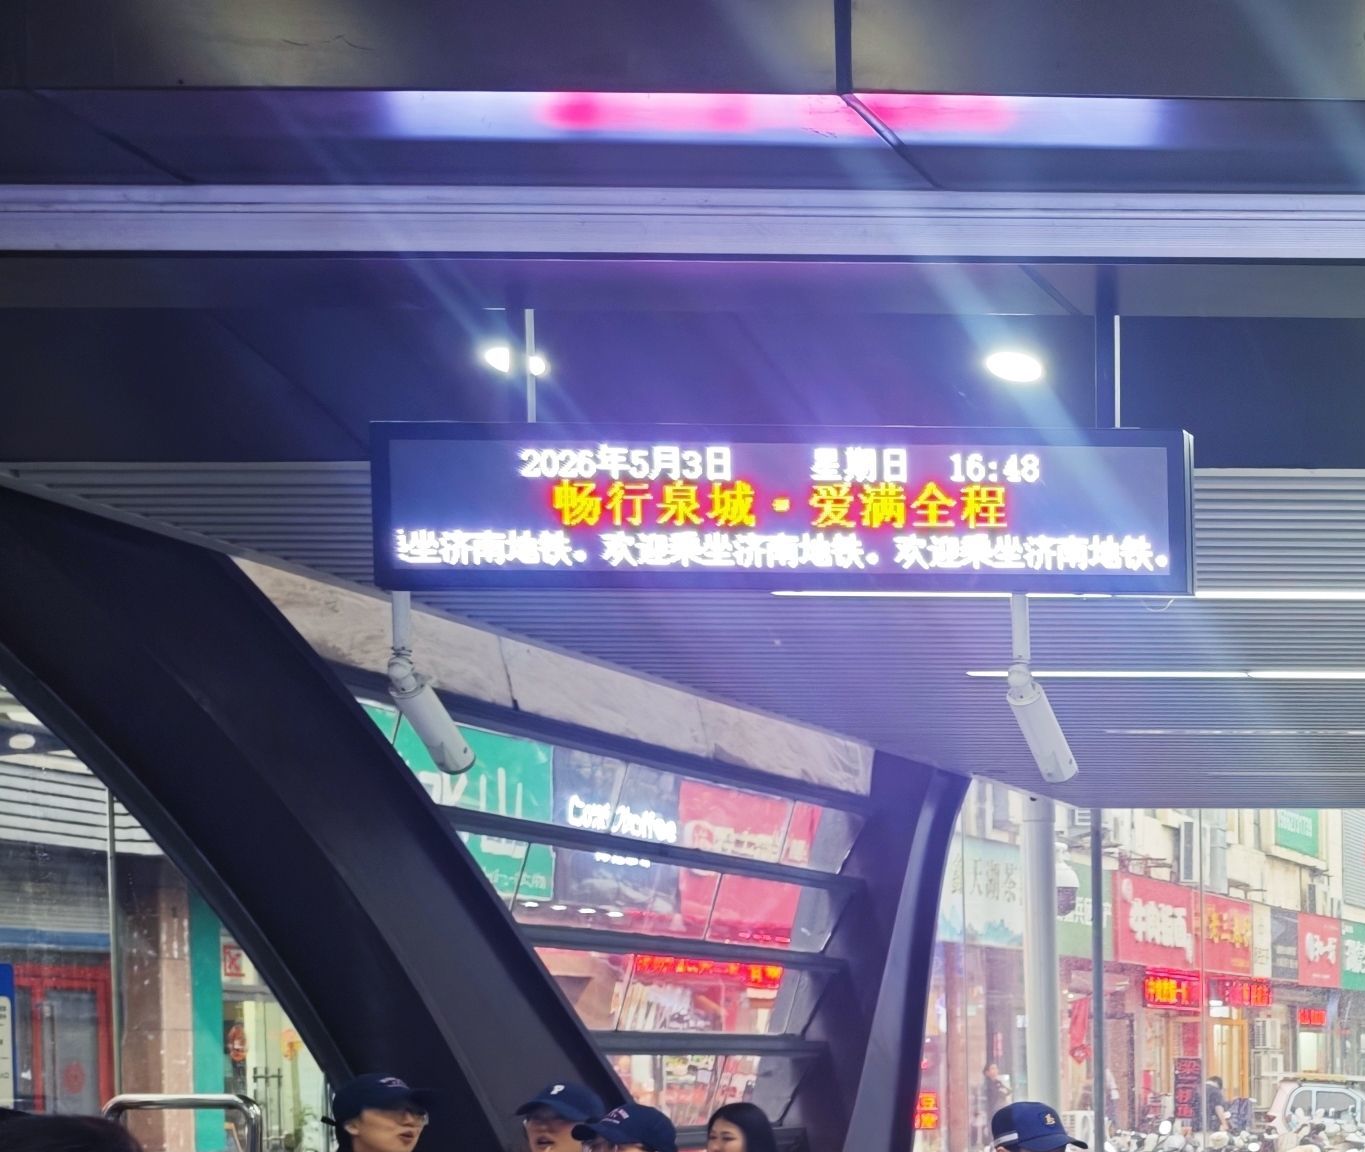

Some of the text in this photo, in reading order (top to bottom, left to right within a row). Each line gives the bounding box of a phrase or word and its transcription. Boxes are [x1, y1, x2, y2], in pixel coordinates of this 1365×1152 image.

[519, 445, 1040, 483] 2026年5月3日 星期日 16:48
